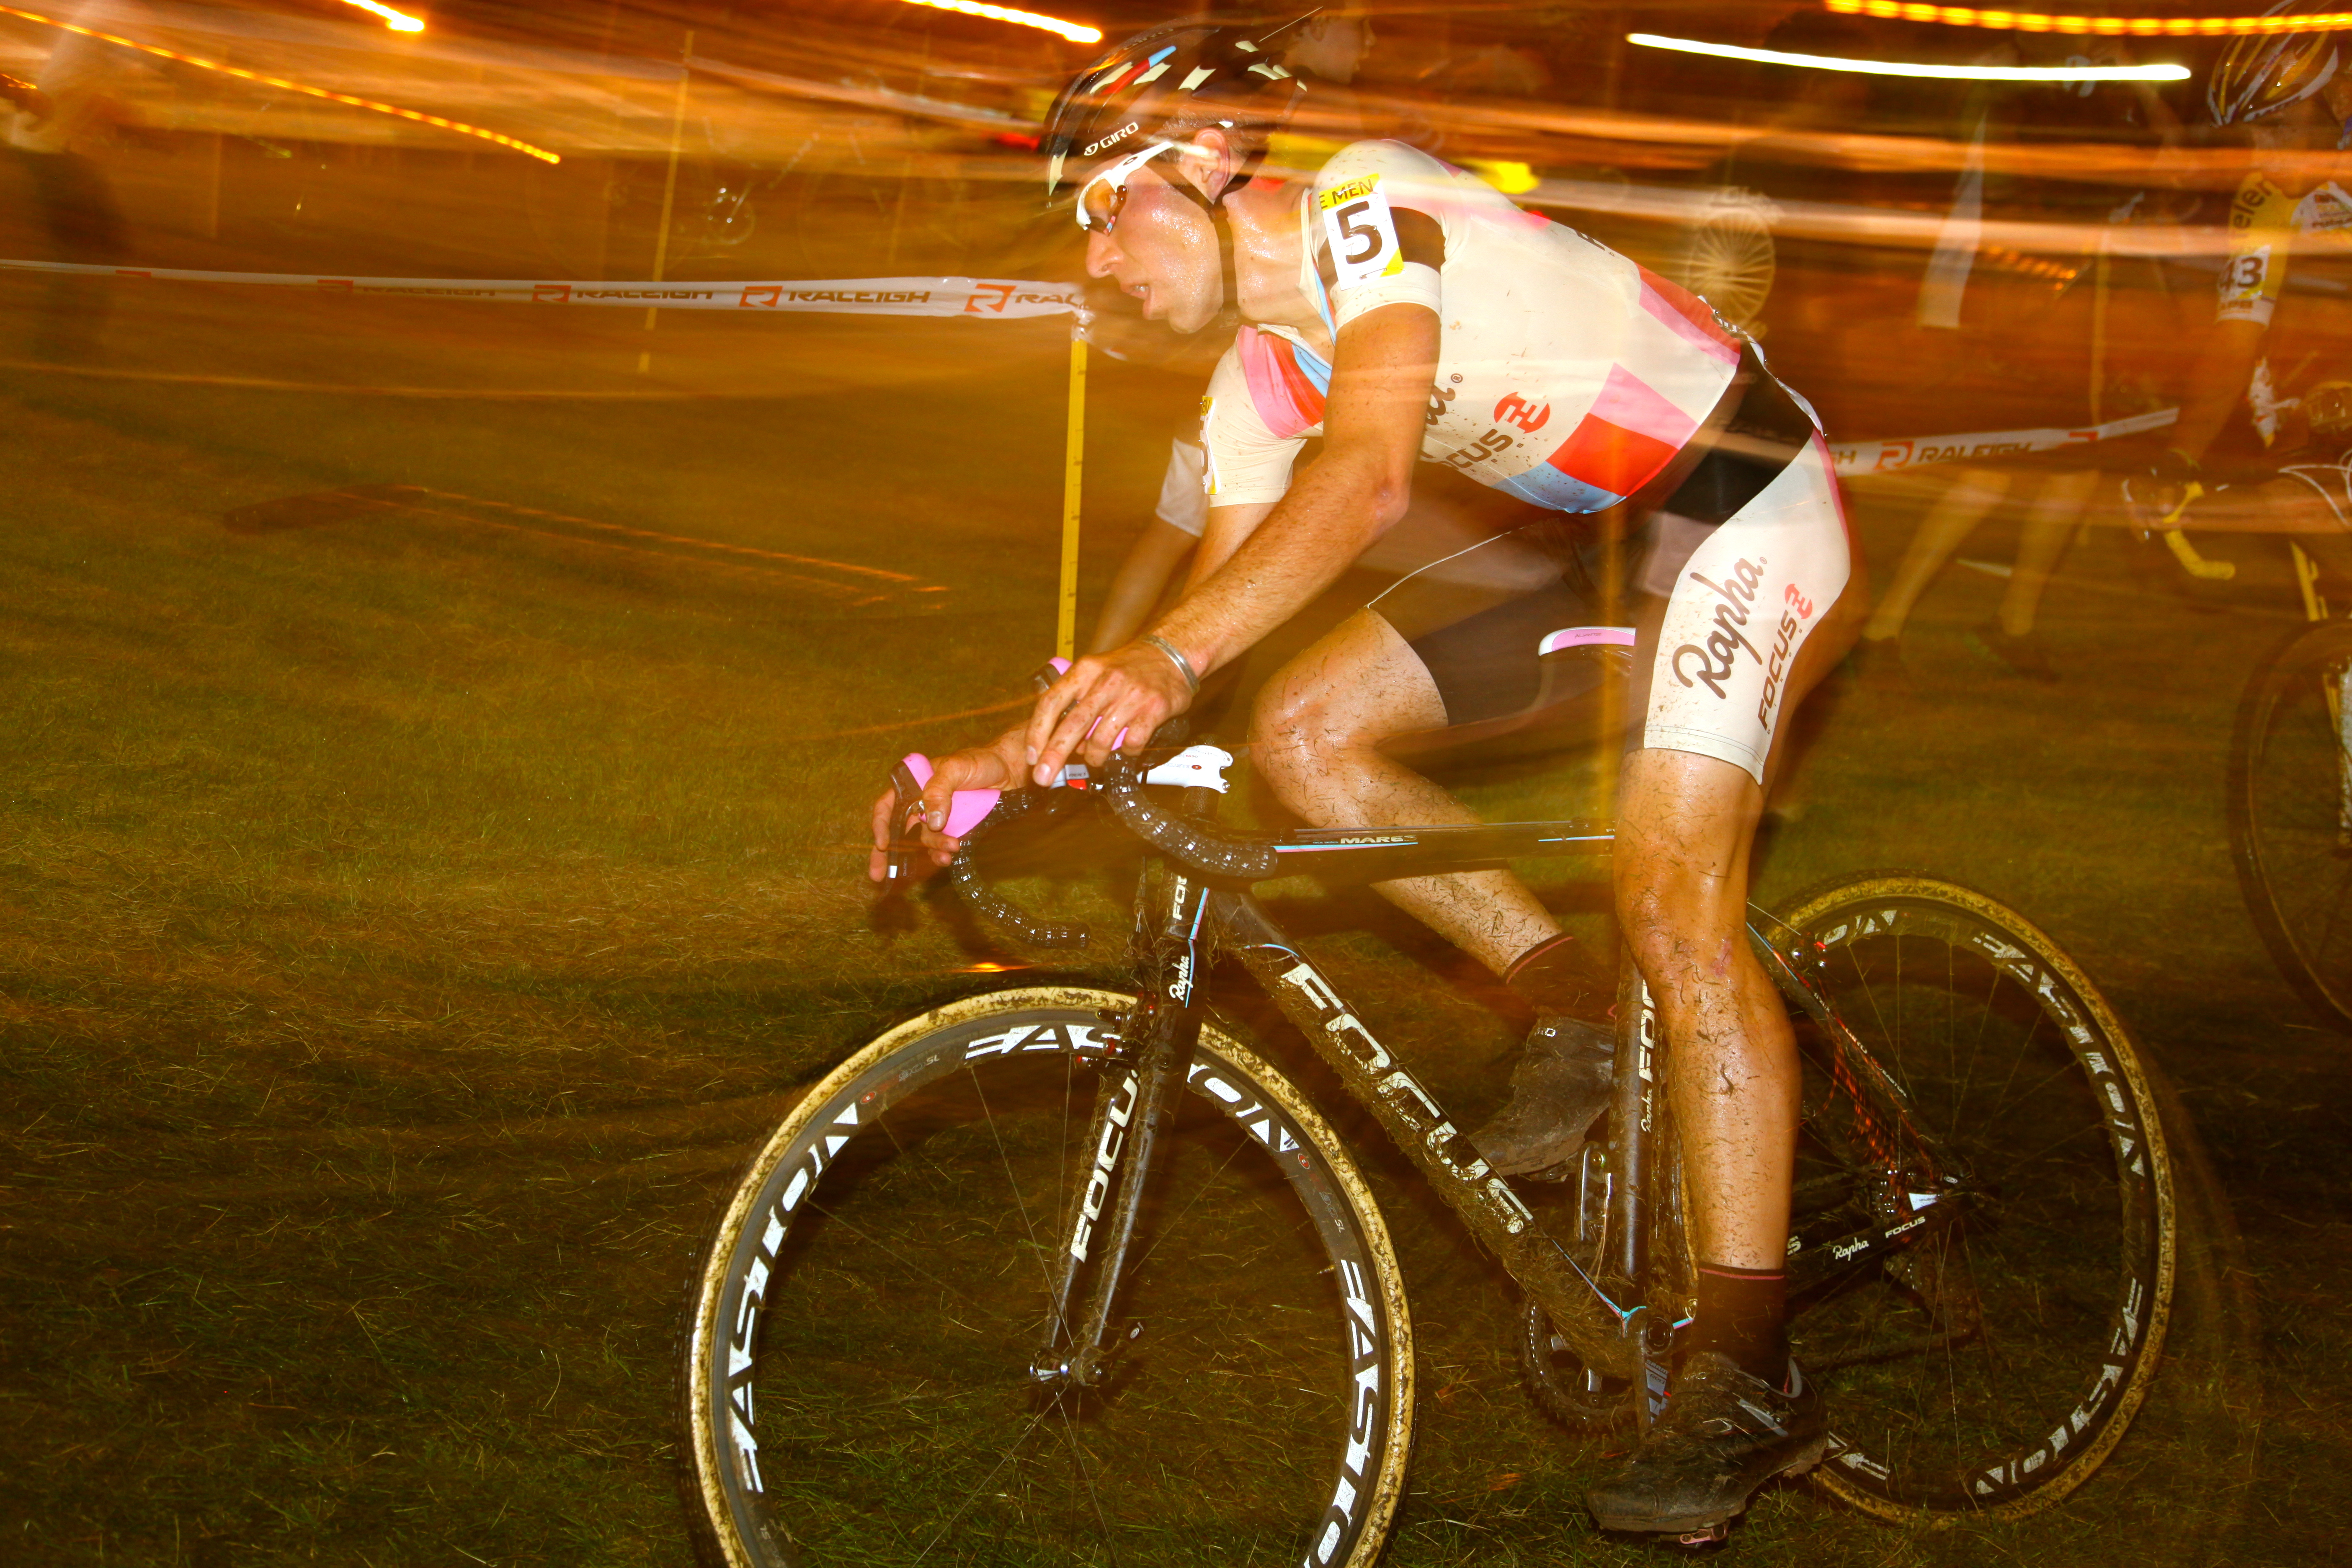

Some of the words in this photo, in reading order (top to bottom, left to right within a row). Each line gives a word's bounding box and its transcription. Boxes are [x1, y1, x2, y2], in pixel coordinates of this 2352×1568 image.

[1100, 122, 1139, 149] GIRO
[1332, 179, 1374, 204] MEN
[1336, 201, 1382, 265] 5
[788, 291, 931, 304] RALEIGH
[1672, 558, 1764, 700] Rapha
[1758, 610, 1797, 731] FOCUS
[1340, 835, 1417, 844] MARES
[1168, 955, 1194, 1001] Rapha
[1280, 963, 1533, 1234] FOCUS
[1972, 931, 2146, 1178] EASTON
[1070, 1069, 1138, 1264] FOCU
[728, 1101, 858, 1493] EASTON
[1832, 1237, 1870, 1261] Rapha
[1885, 1216, 1926, 1238] FOCUS
[1303, 1259, 1379, 1568] EASTO
[1976, 1276, 2144, 1495] EASTON
